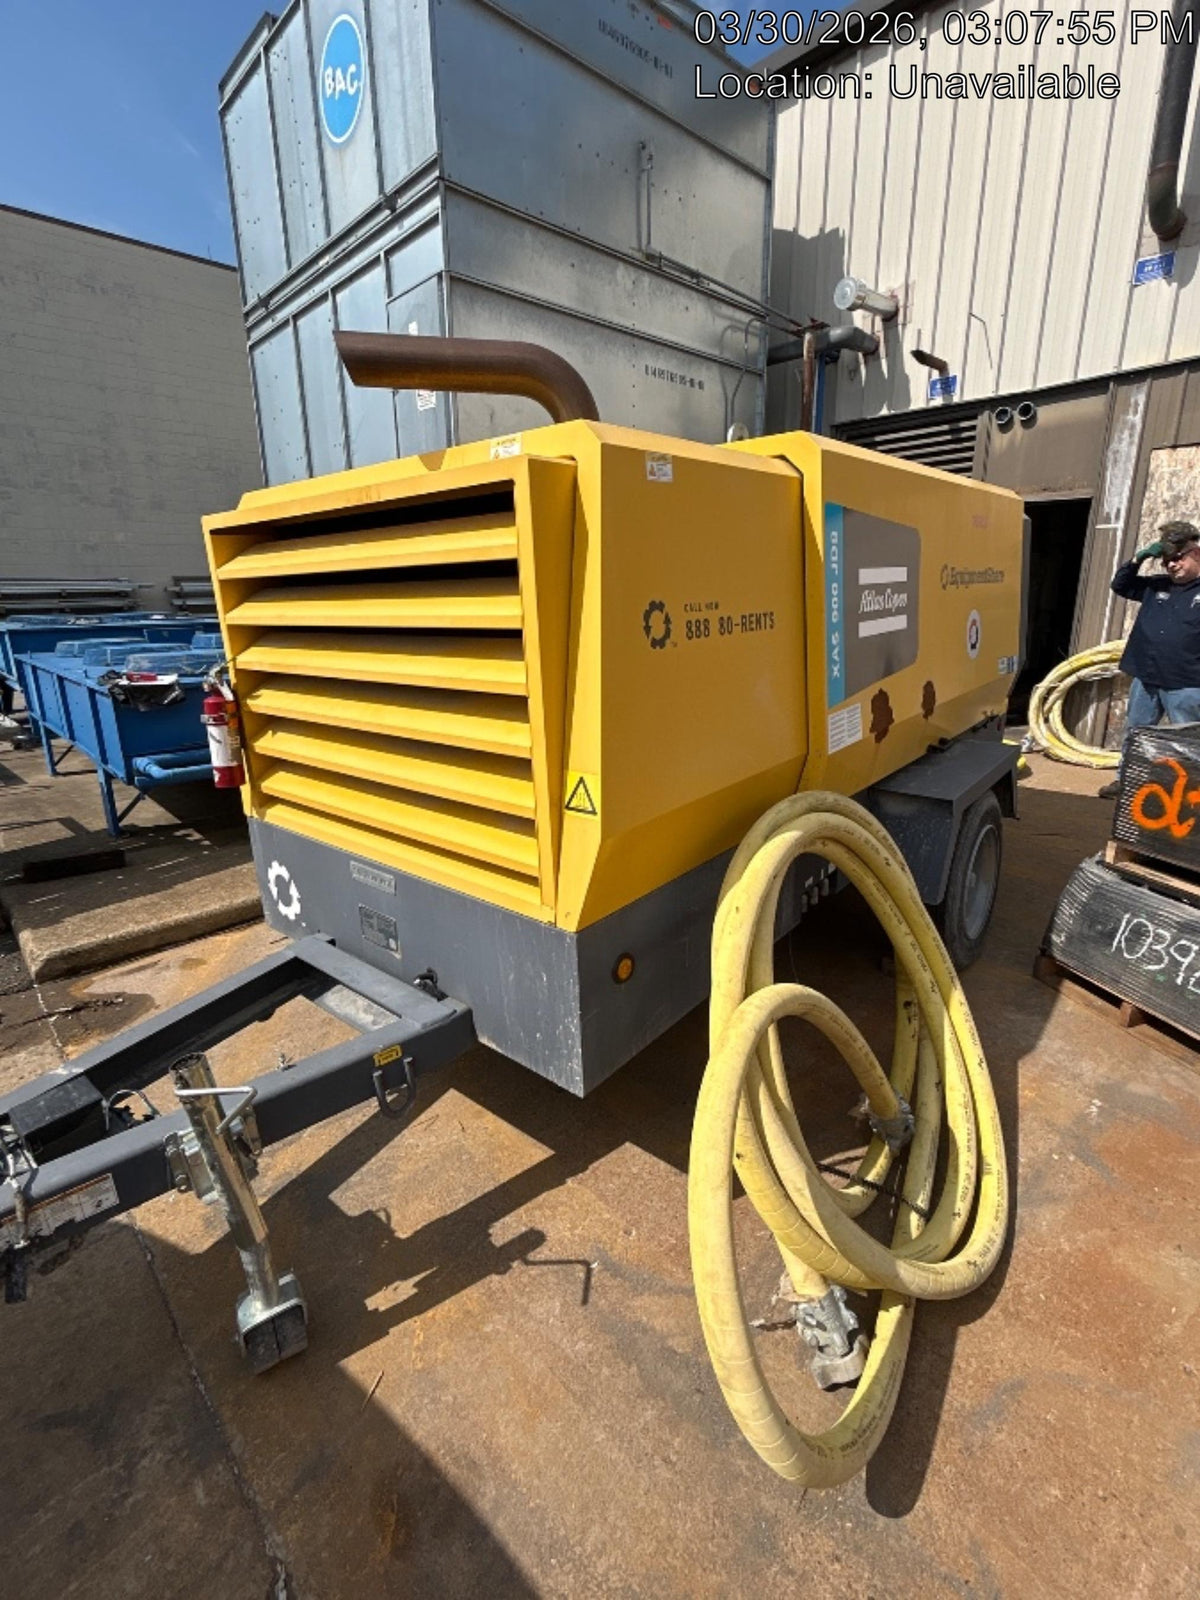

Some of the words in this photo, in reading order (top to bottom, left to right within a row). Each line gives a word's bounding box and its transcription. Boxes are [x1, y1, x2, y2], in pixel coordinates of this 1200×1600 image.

[325, 63, 358, 99] BAC
[858, 589, 884, 614] Atlas
[884, 588, 908, 613] Copco
[685, 618, 710, 640] 888
[718, 611, 775, 636] 80-RENTS
[831, 631, 840, 680] XAS
